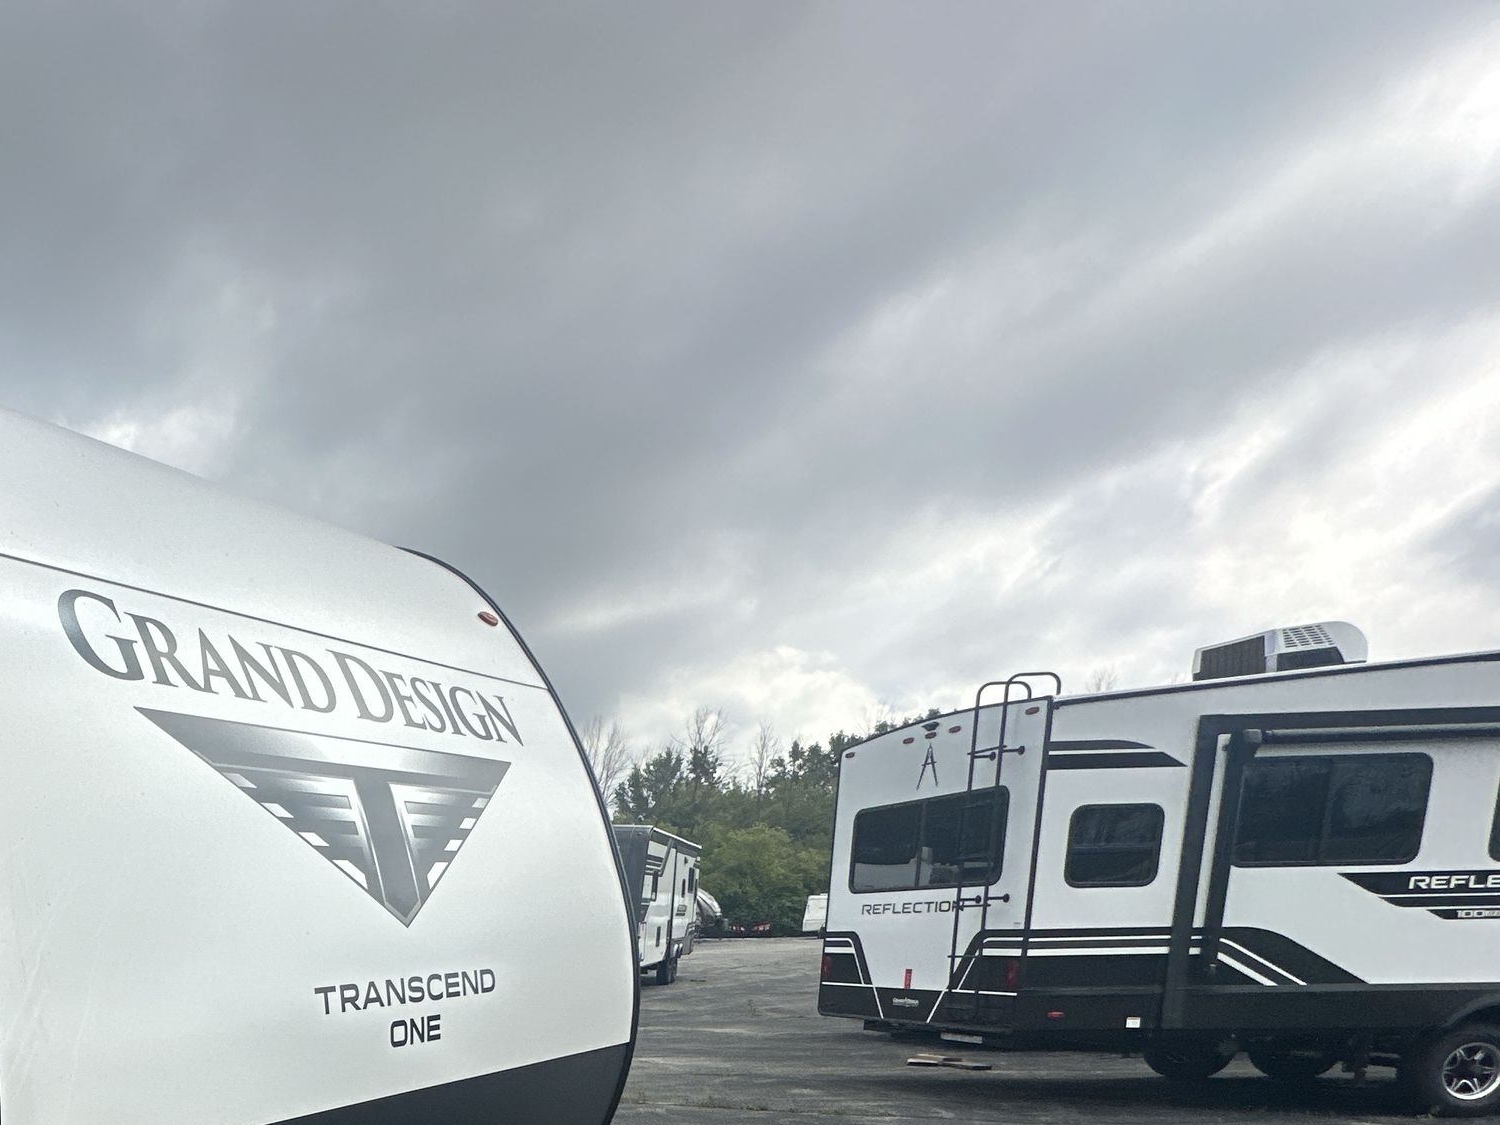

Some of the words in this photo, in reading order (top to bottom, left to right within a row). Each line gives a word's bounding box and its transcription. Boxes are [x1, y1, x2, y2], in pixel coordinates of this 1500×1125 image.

[57, 589, 337, 714] GRAND
[326, 649, 524, 746] DESIGN
[314, 968, 496, 1016] TRANSCEND
[389, 1014, 442, 1048] ONE
